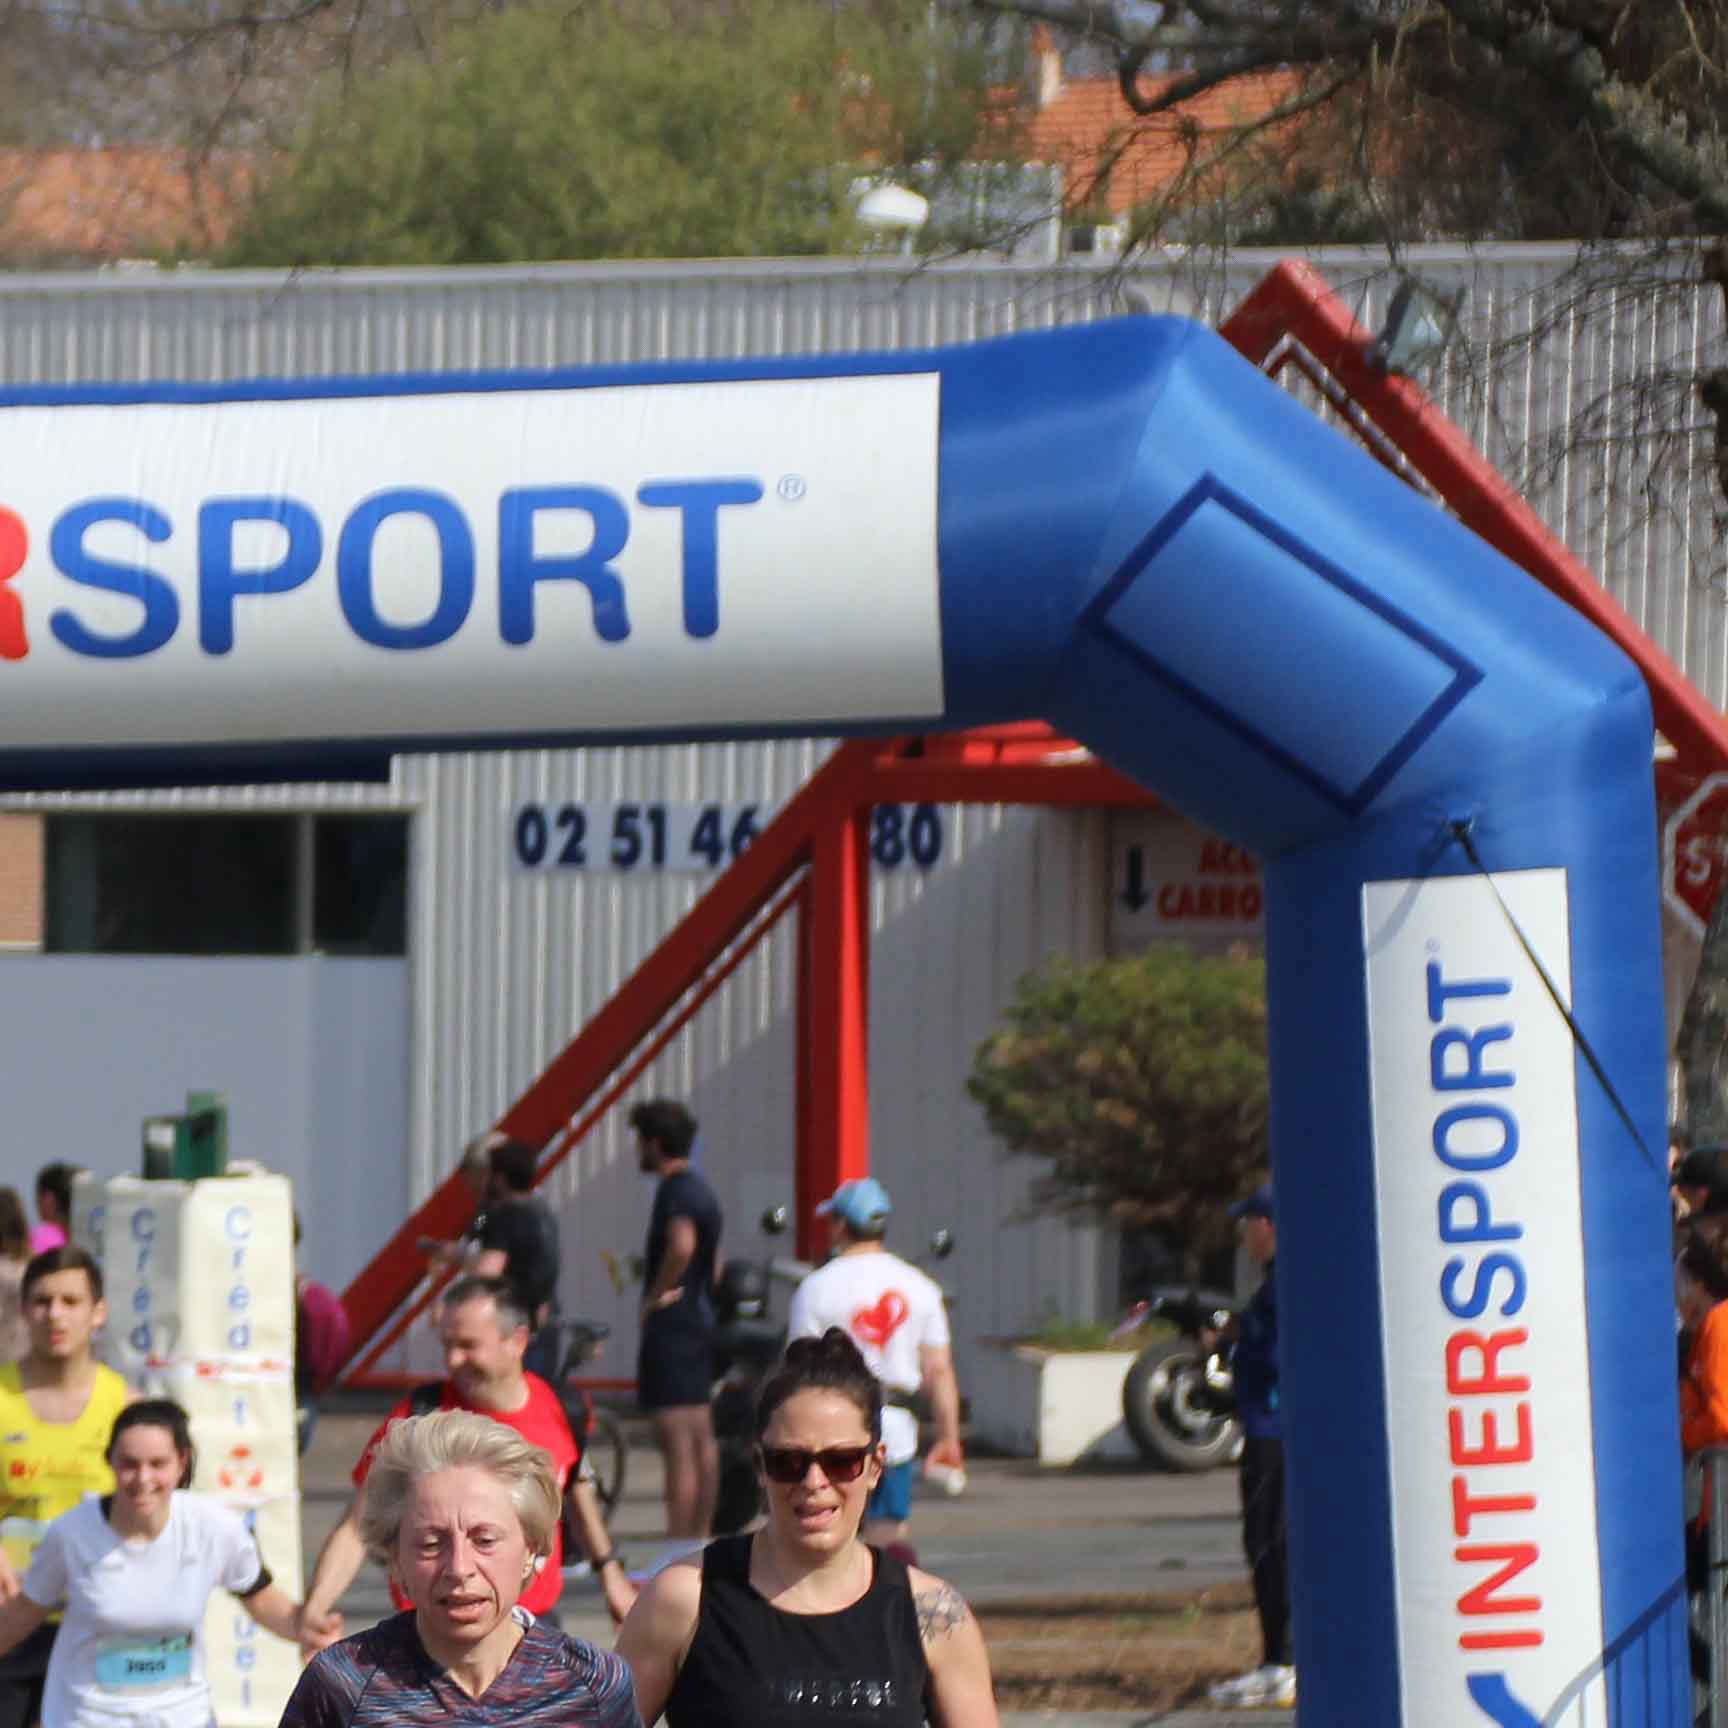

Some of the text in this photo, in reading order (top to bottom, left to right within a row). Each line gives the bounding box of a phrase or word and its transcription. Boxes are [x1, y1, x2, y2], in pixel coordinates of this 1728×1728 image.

[515, 804, 586, 866] 02
[610, 804, 666, 869] 51
[872, 802, 943, 868] 80
[1426, 960, 1544, 1652] INTERSPORT
